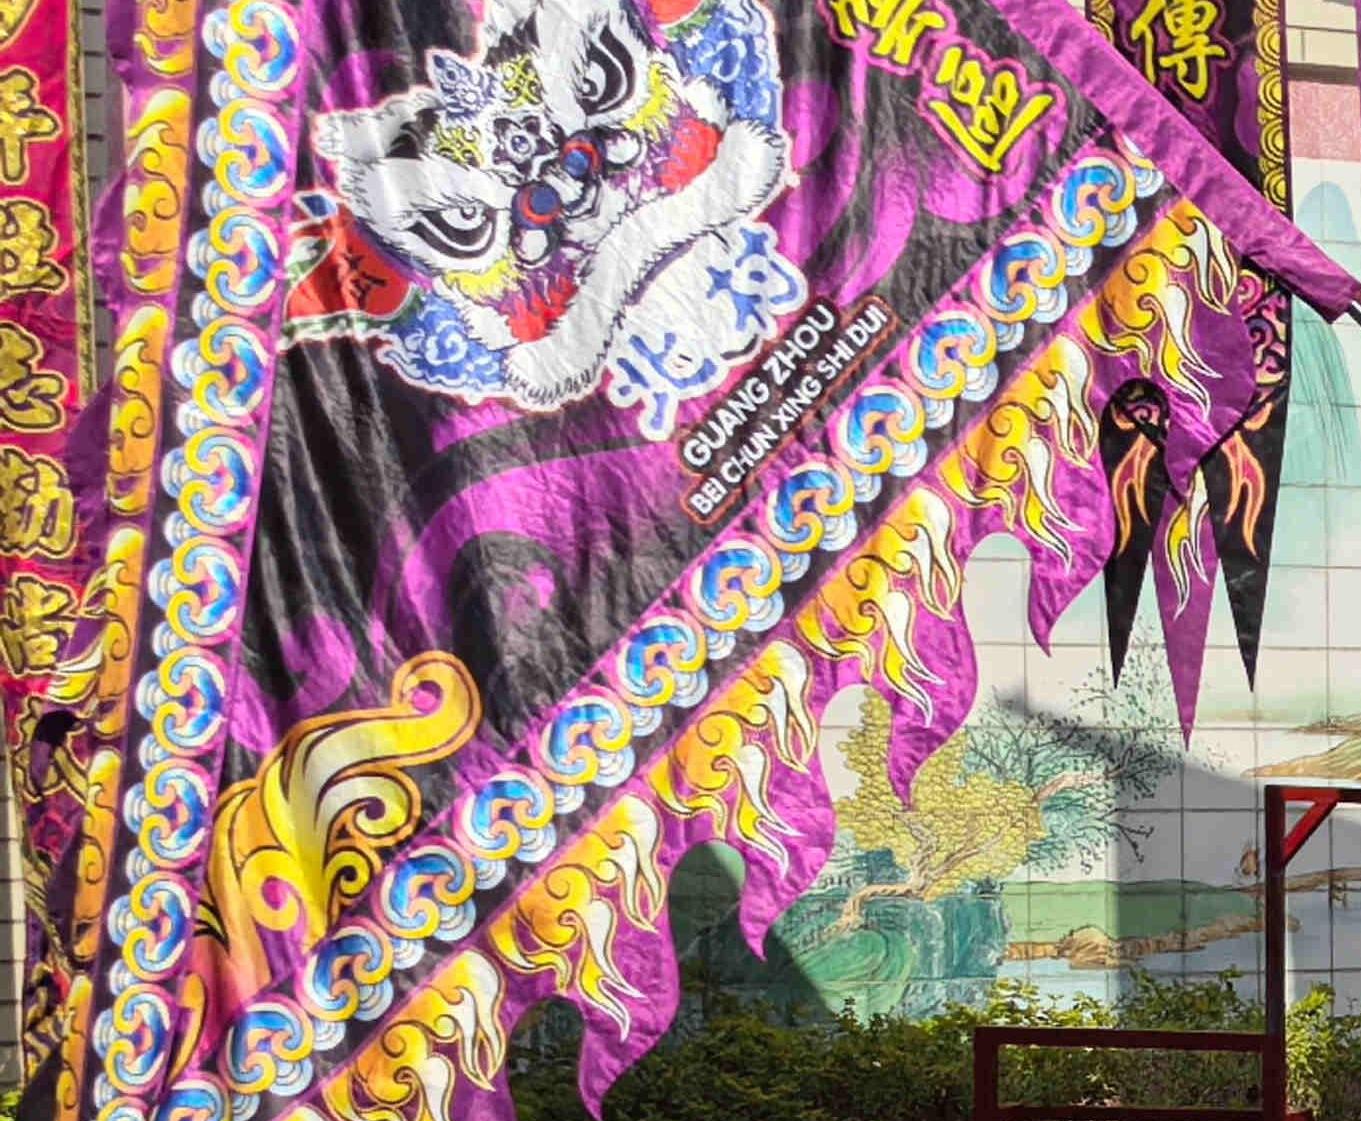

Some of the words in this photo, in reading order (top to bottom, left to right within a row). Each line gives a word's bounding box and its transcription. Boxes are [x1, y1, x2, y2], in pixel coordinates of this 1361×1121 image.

[617, 226, 798, 431] 北村
[682, 376, 771, 468] GUANG
[762, 303, 836, 386] ZHOU
[688, 476, 728, 516] BEI
[719, 425, 779, 485] CHUN
[770, 375, 824, 431] XING
[817, 337, 857, 381] SHI
[845, 304, 889, 346] DUI
